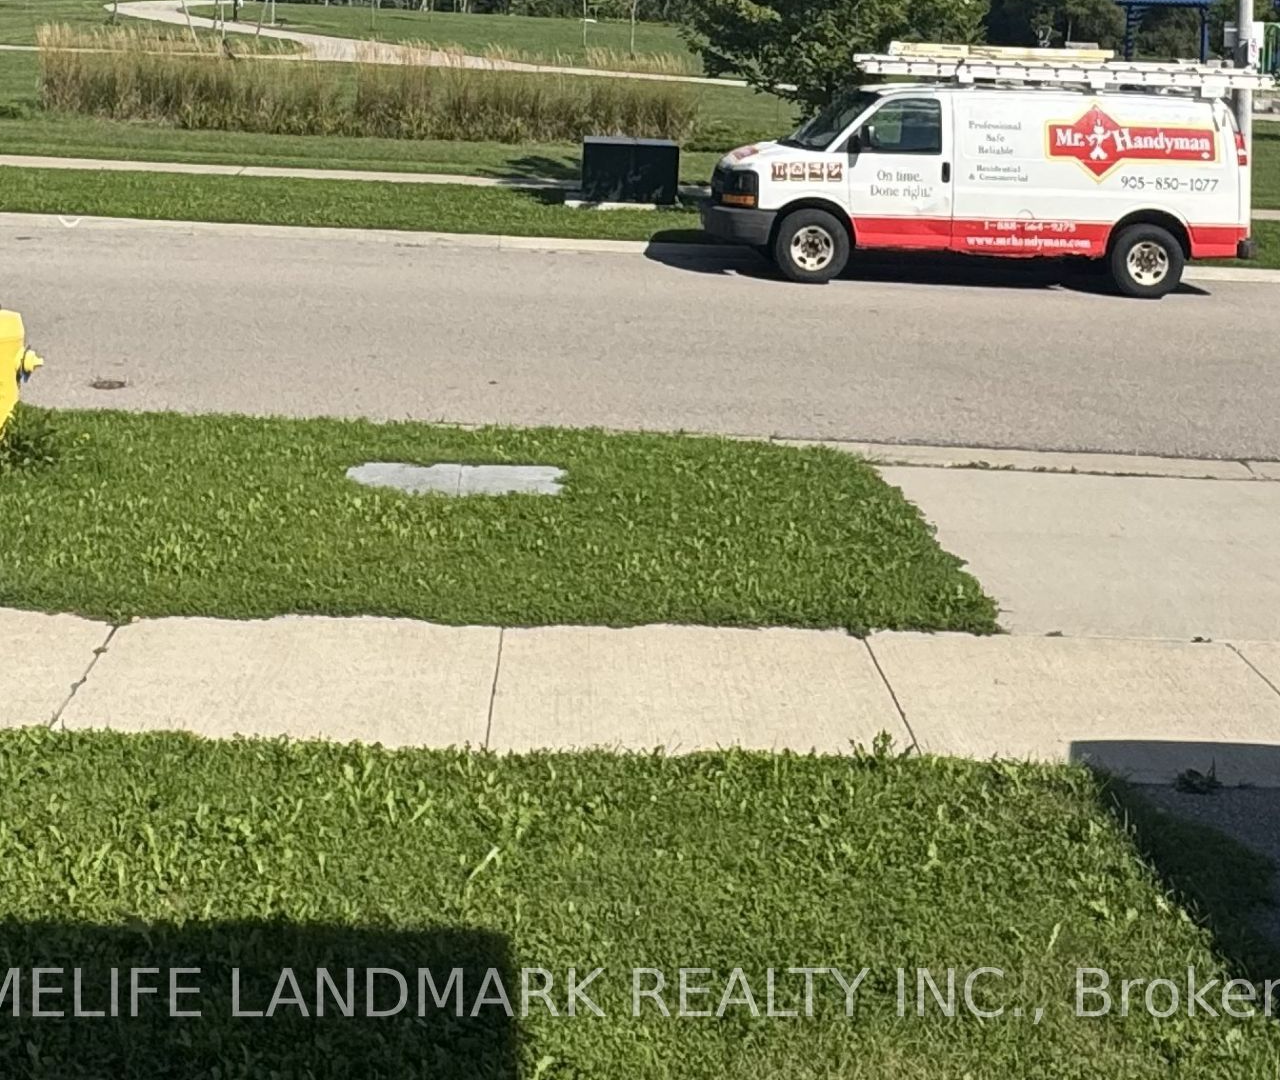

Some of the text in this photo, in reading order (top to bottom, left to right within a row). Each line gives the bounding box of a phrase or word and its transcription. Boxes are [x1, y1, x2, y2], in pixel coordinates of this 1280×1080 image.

[985, 133, 1005, 143] Safe
[1055, 127, 1211, 154] Mr. Handyman
[876, 169, 893, 182] On
[870, 184, 900, 197] Done
[1120, 175, 1219, 192] 905-850-1077
[966, 235, 1091, 251] www.mrhandyman.com
